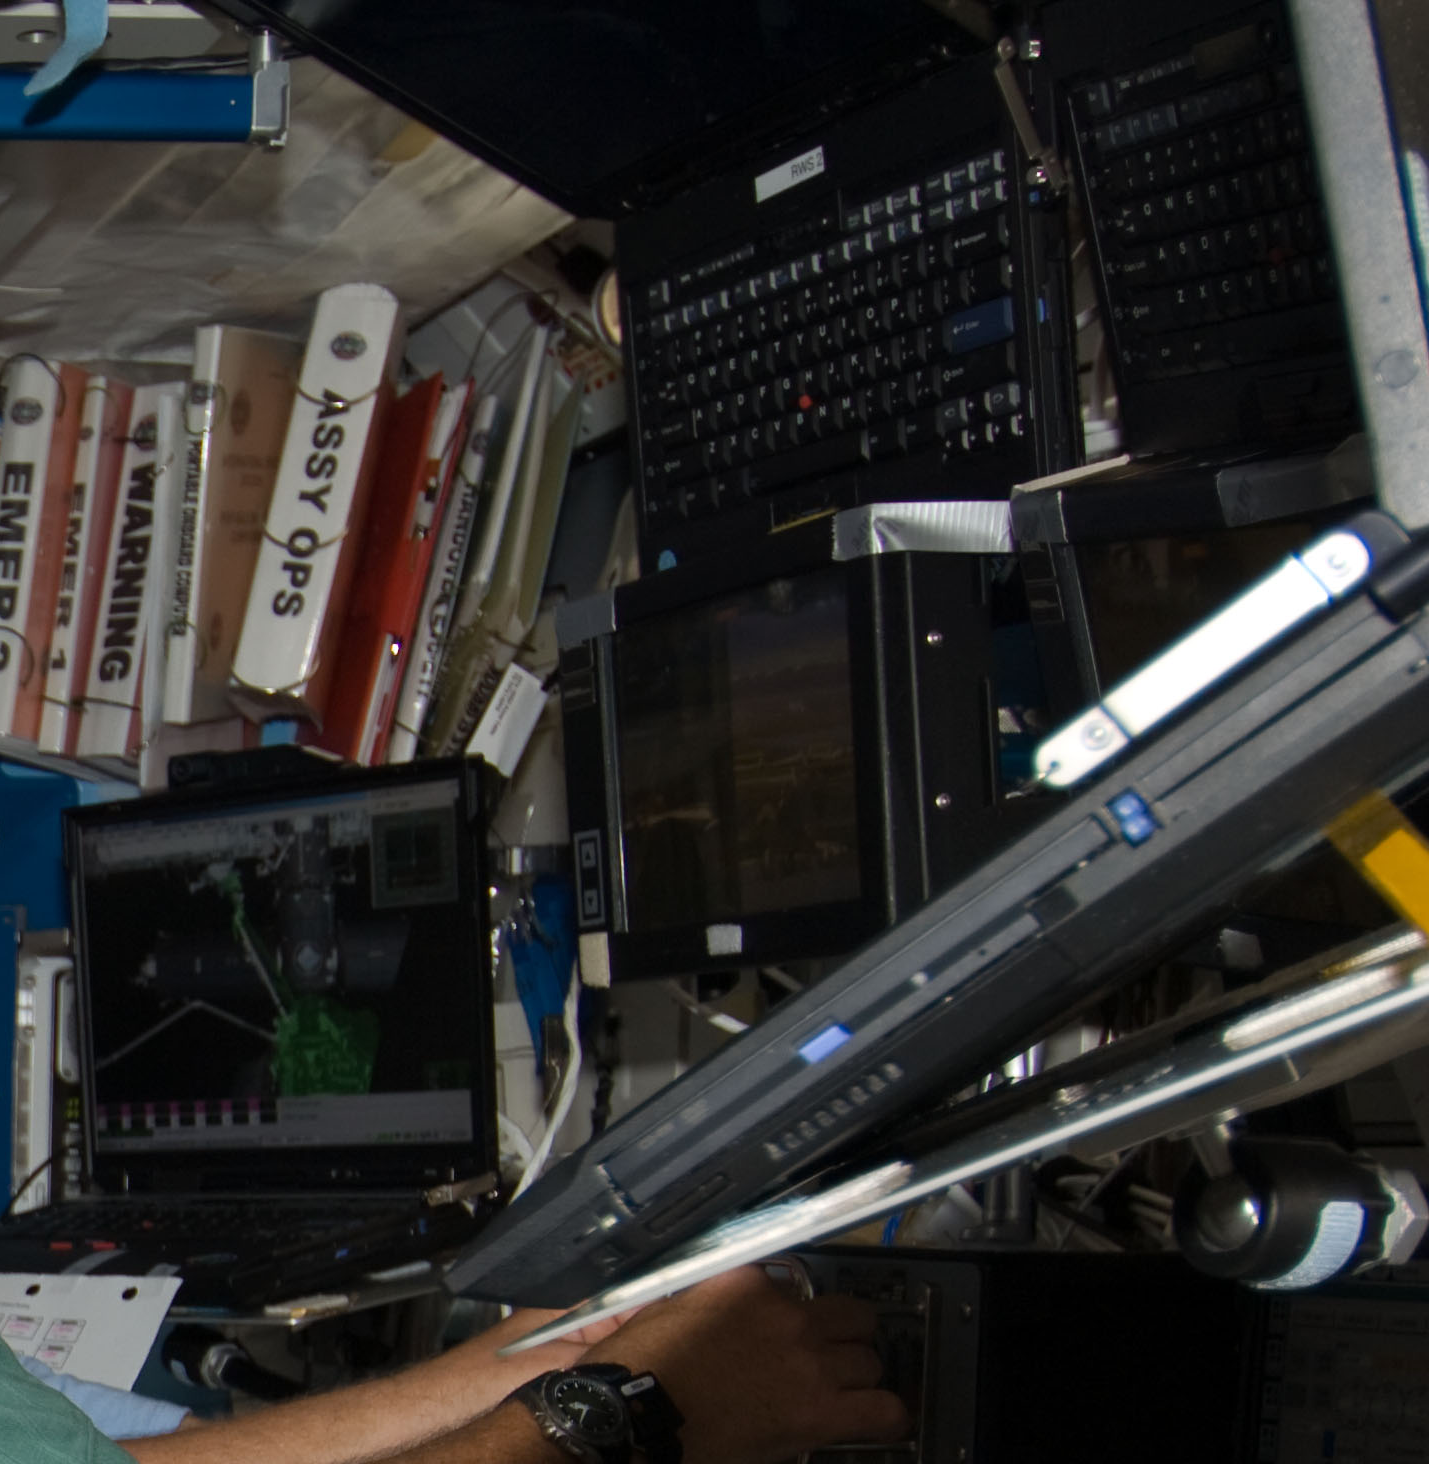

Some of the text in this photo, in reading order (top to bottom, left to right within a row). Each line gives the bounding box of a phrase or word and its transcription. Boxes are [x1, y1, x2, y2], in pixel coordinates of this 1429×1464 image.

[790, 152, 823, 180] RWS 2
[53, 484, 86, 629] EMER
[97, 461, 154, 682] WARNING
[171, 440, 201, 637] PORTABLE ONBOARD COMPUTER
[272, 388, 350, 618] ASSY OPS
